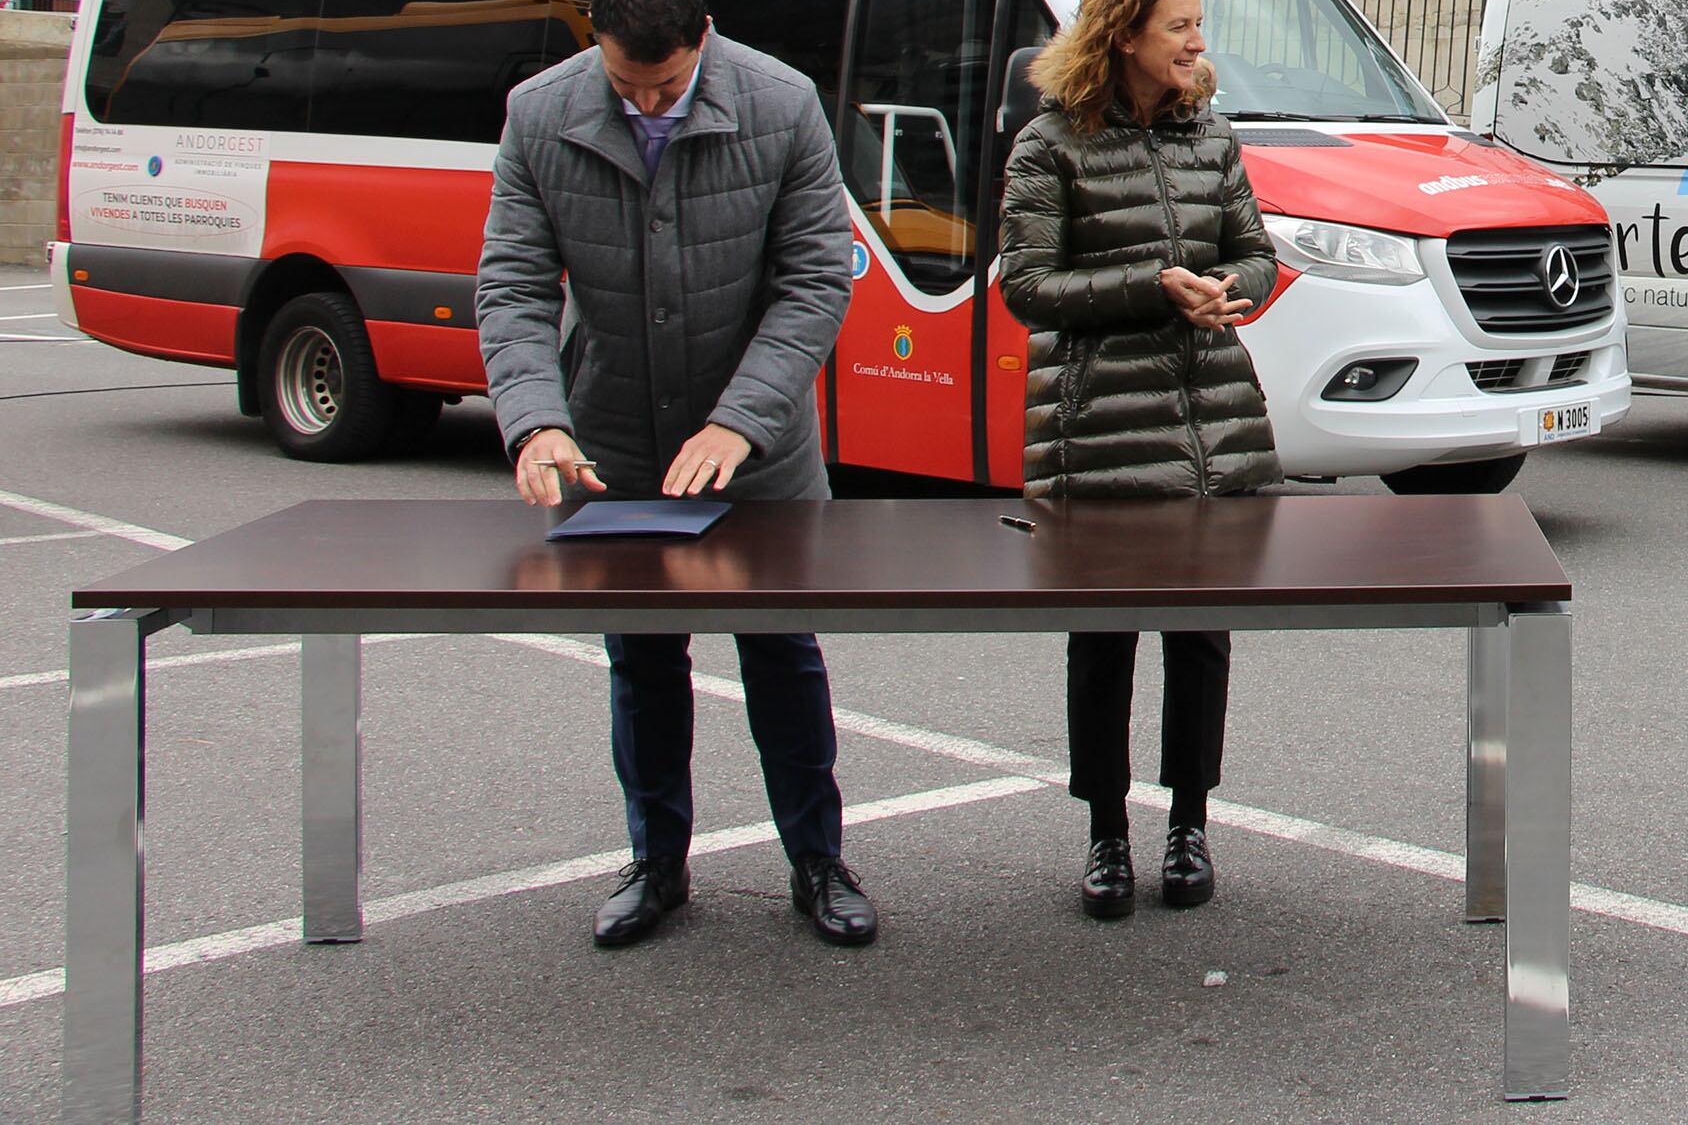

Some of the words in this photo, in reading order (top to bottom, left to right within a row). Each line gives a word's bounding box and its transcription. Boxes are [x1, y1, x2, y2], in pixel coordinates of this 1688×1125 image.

[176, 134, 264, 152] ANDORGEST
[103, 192, 128, 204] TENIM
[130, 194, 163, 206] CLIENTS
[165, 197, 182, 209] QUE
[185, 198, 227, 211] BUSQUEN
[90, 207, 131, 220] VIVENDES
[132, 209, 138, 220] A
[140, 210, 166, 223] TOTES
[168, 213, 182, 224] LES
[853, 362, 878, 376] Comú
[880, 366, 922, 382] d'Andorra
[924, 371, 931, 382] la
[933, 372, 954, 385] Vella
[1557, 410, 1564, 431] N
[1566, 406, 1588, 430] 3005
